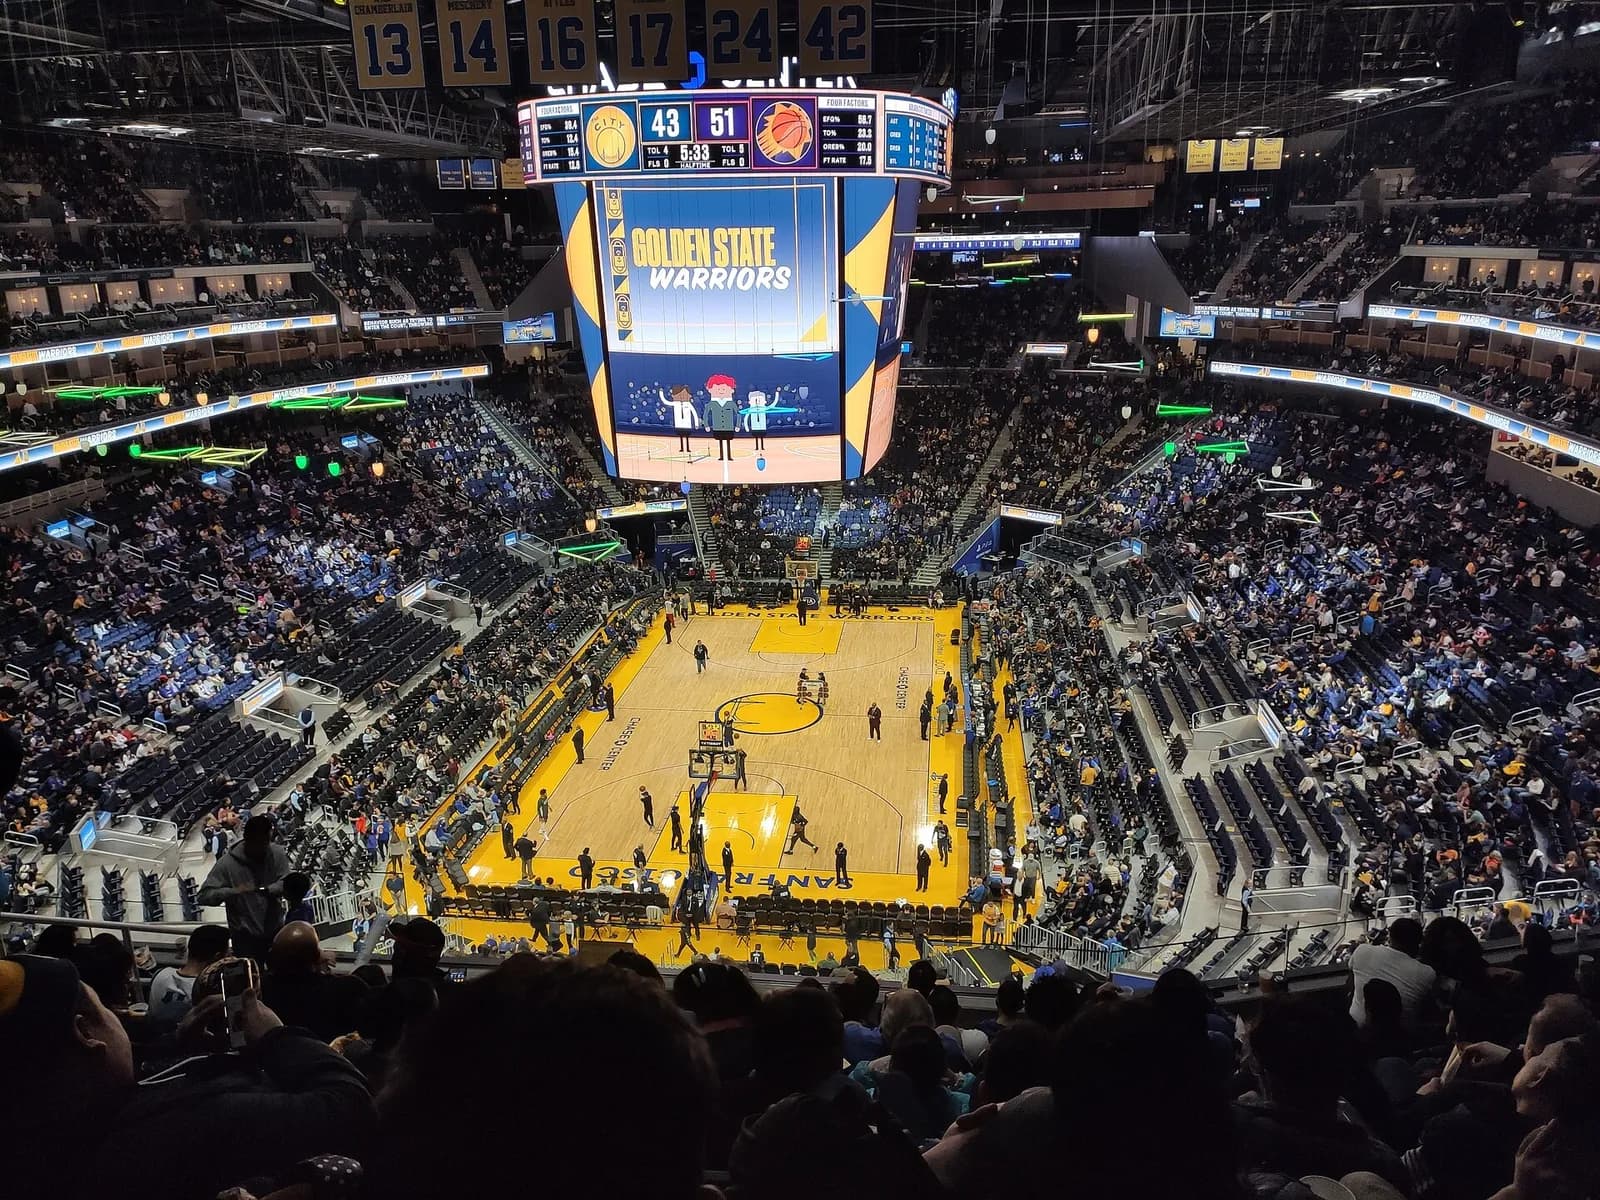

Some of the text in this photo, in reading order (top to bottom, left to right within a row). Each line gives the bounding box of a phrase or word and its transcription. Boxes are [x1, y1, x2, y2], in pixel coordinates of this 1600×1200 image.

[364, 23, 411, 76] 13
[451, 20, 498, 73] 14
[538, 17, 586, 70] 16
[629, 14, 673, 67] 17
[712, 9, 772, 64] 24
[804, 5, 866, 61] 42
[594, 118, 626, 132] CITY
[651, 108, 680, 138] 43
[710, 108, 734, 136] 51
[663, 146, 668, 155] 4
[664, 158, 670, 168] 0
[680, 144, 710, 161] 5:33
[739, 158, 744, 167] 0
[631, 226, 776, 268] GOLDEN STATE
[650, 266, 792, 291] WARRIORS
[598, 717, 641, 770] CHASE CENTER
